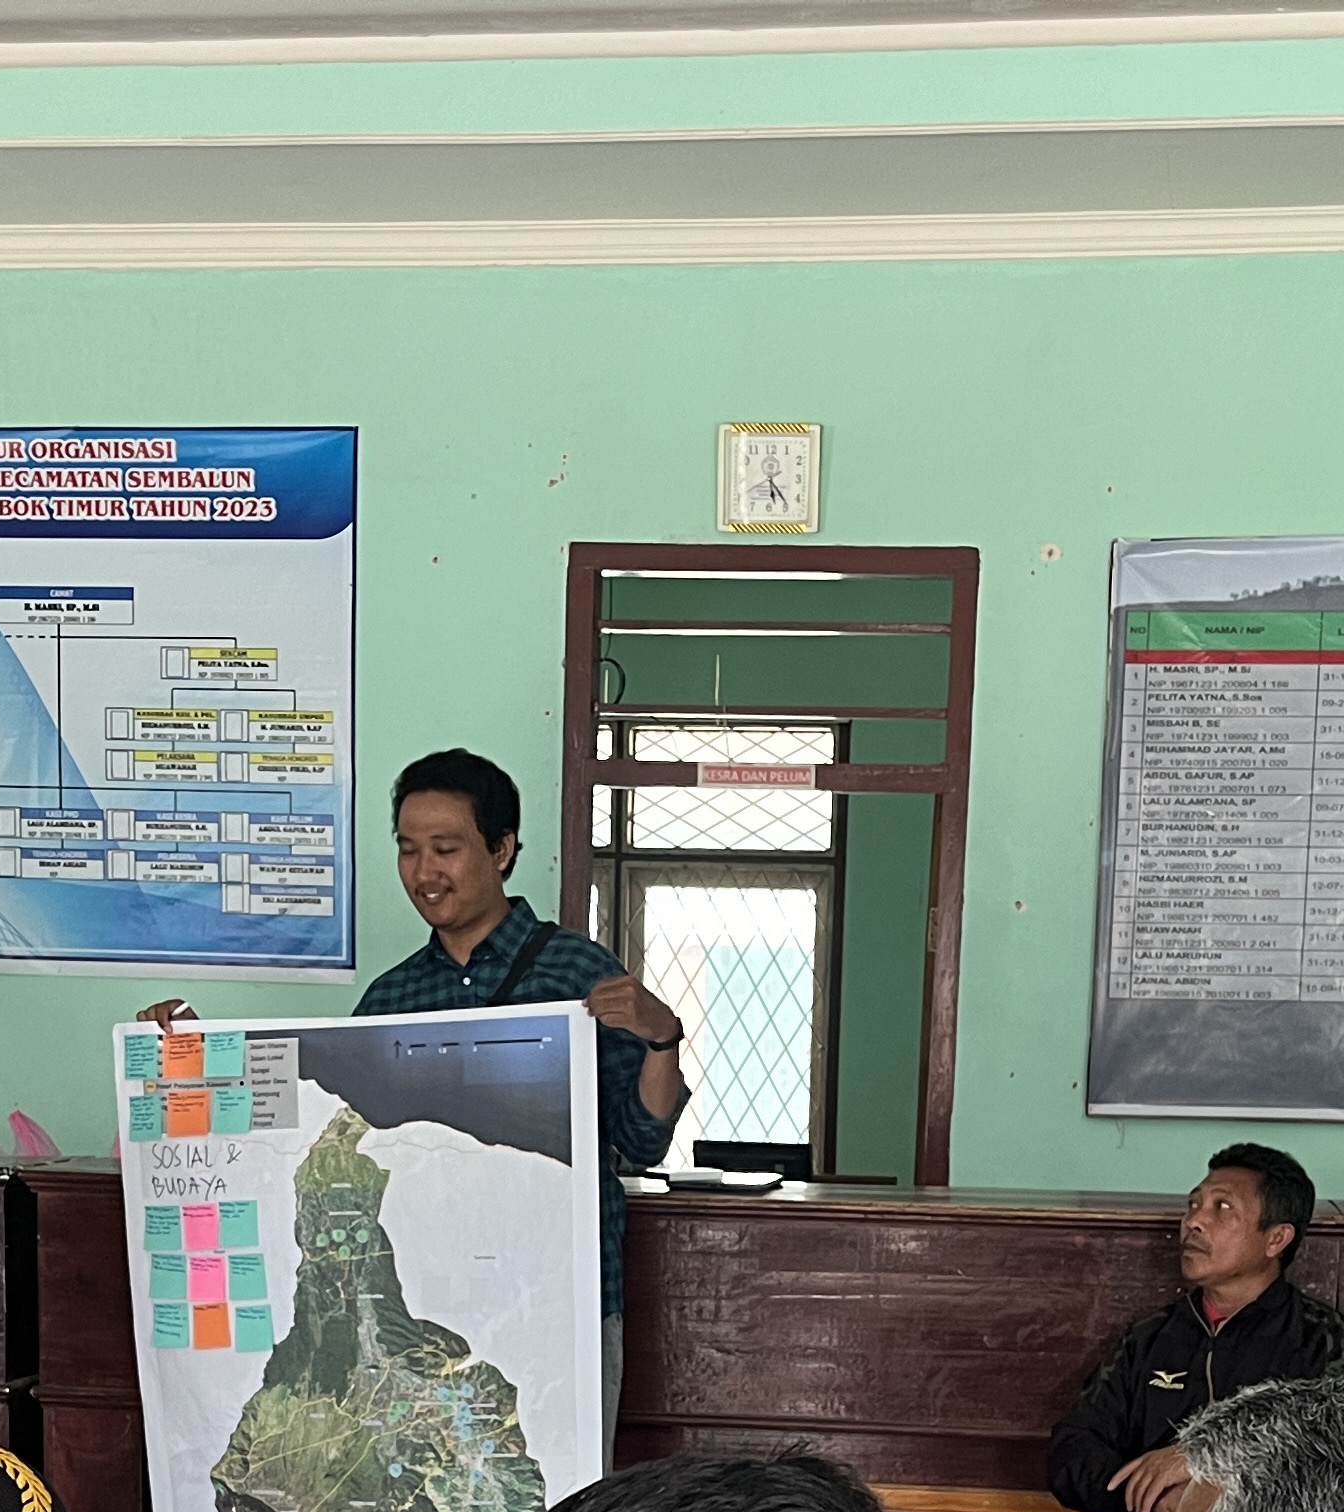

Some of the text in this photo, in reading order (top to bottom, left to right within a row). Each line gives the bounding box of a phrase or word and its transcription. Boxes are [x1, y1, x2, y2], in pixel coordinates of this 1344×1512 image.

[30, 440, 174, 460] ORGANISASI
[765, 444, 777, 455] 12
[795, 455, 803, 466] 2
[126, 470, 252, 489] SEMBALUN
[794, 473, 802, 484] 3
[51, 499, 126, 518] TIMUR
[131, 499, 208, 518] TAHUN
[215, 499, 274, 518] 2023
[765, 502, 773, 513] 6
[1205, 626, 1237, 635] NAMA
[1145, 746, 1211, 754] MUHAMMAD
[741, 770, 768, 782] DAN
[770, 770, 811, 783] PELUM
[151, 1143, 242, 1169] SOSIAL &
[151, 1175, 228, 1201] BUDAYA
